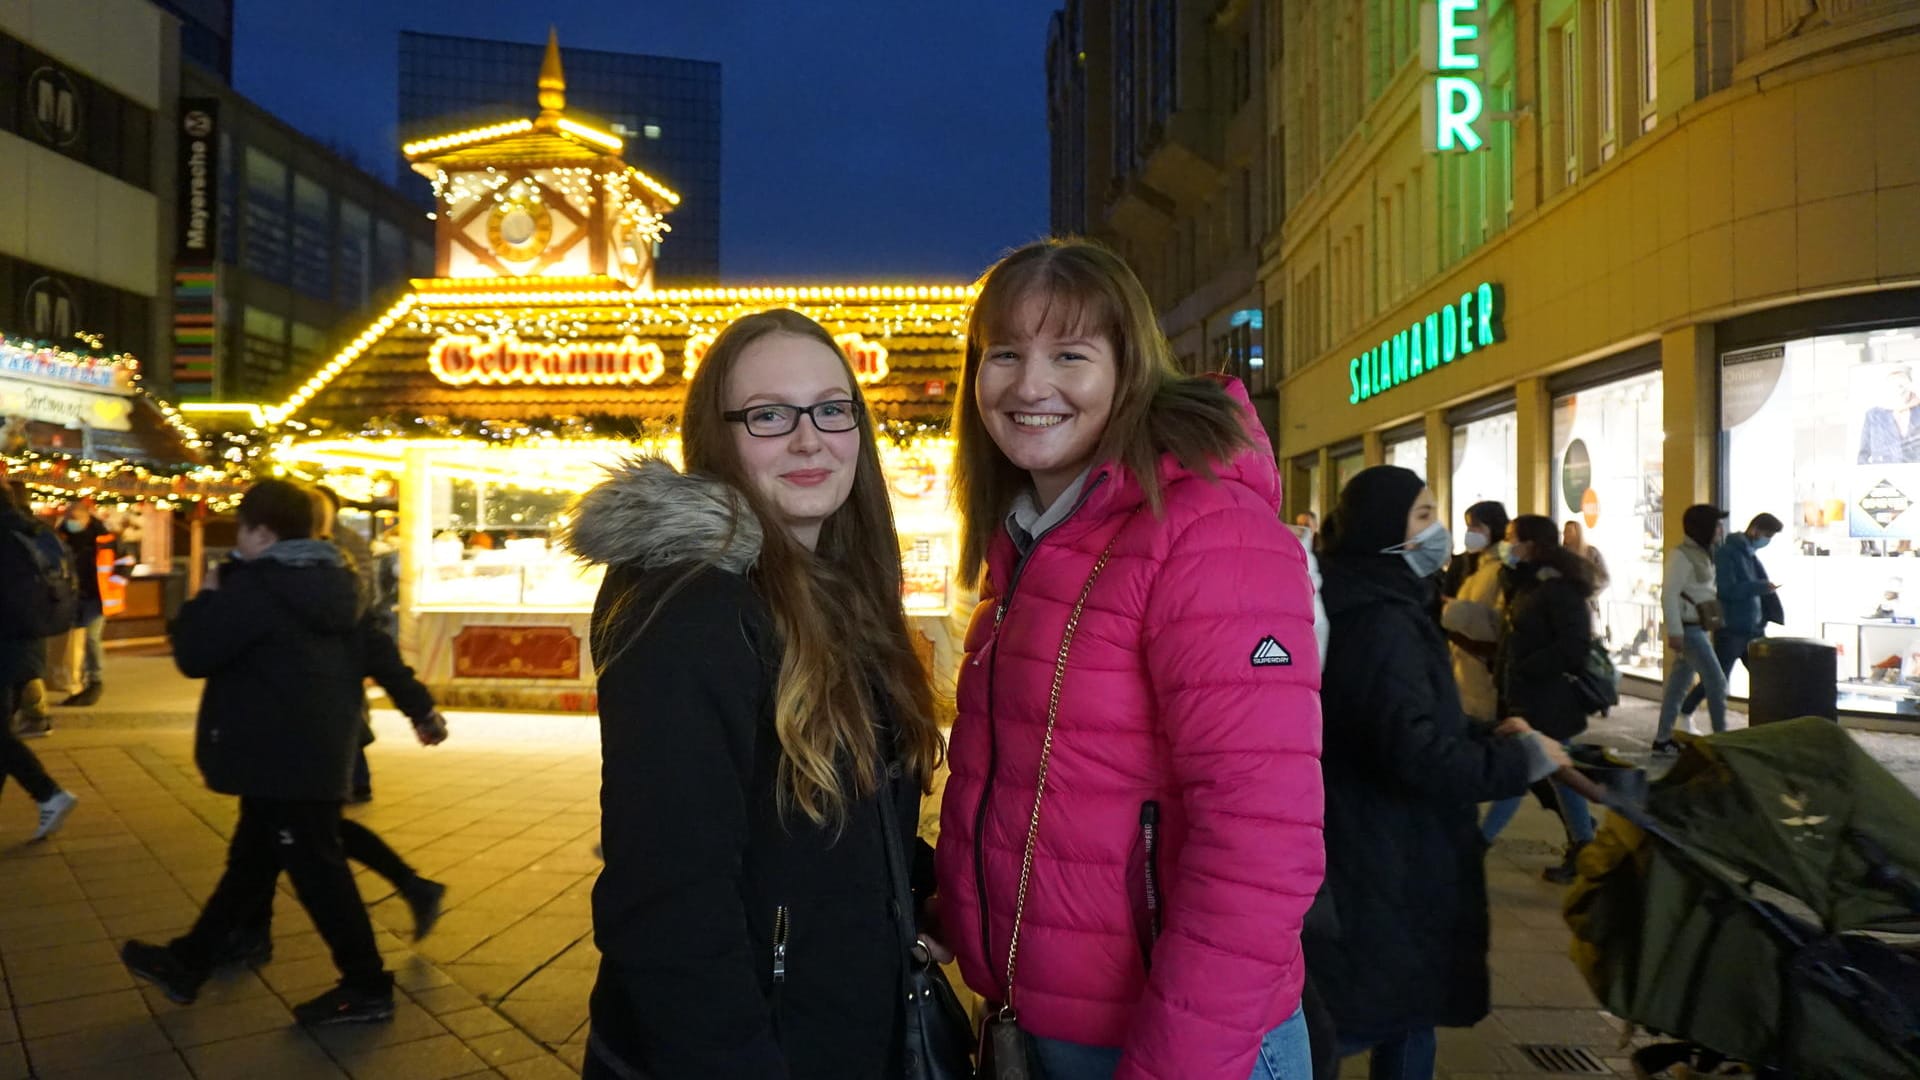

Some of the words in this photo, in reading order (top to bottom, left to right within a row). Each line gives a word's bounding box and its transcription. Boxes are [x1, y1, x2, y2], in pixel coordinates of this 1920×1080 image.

[1436, 0, 1483, 152] ER
[186, 141, 209, 249] Mayersche
[440, 343, 654, 375] Gebrannte
[1349, 282, 1494, 405] SALAMANDER
